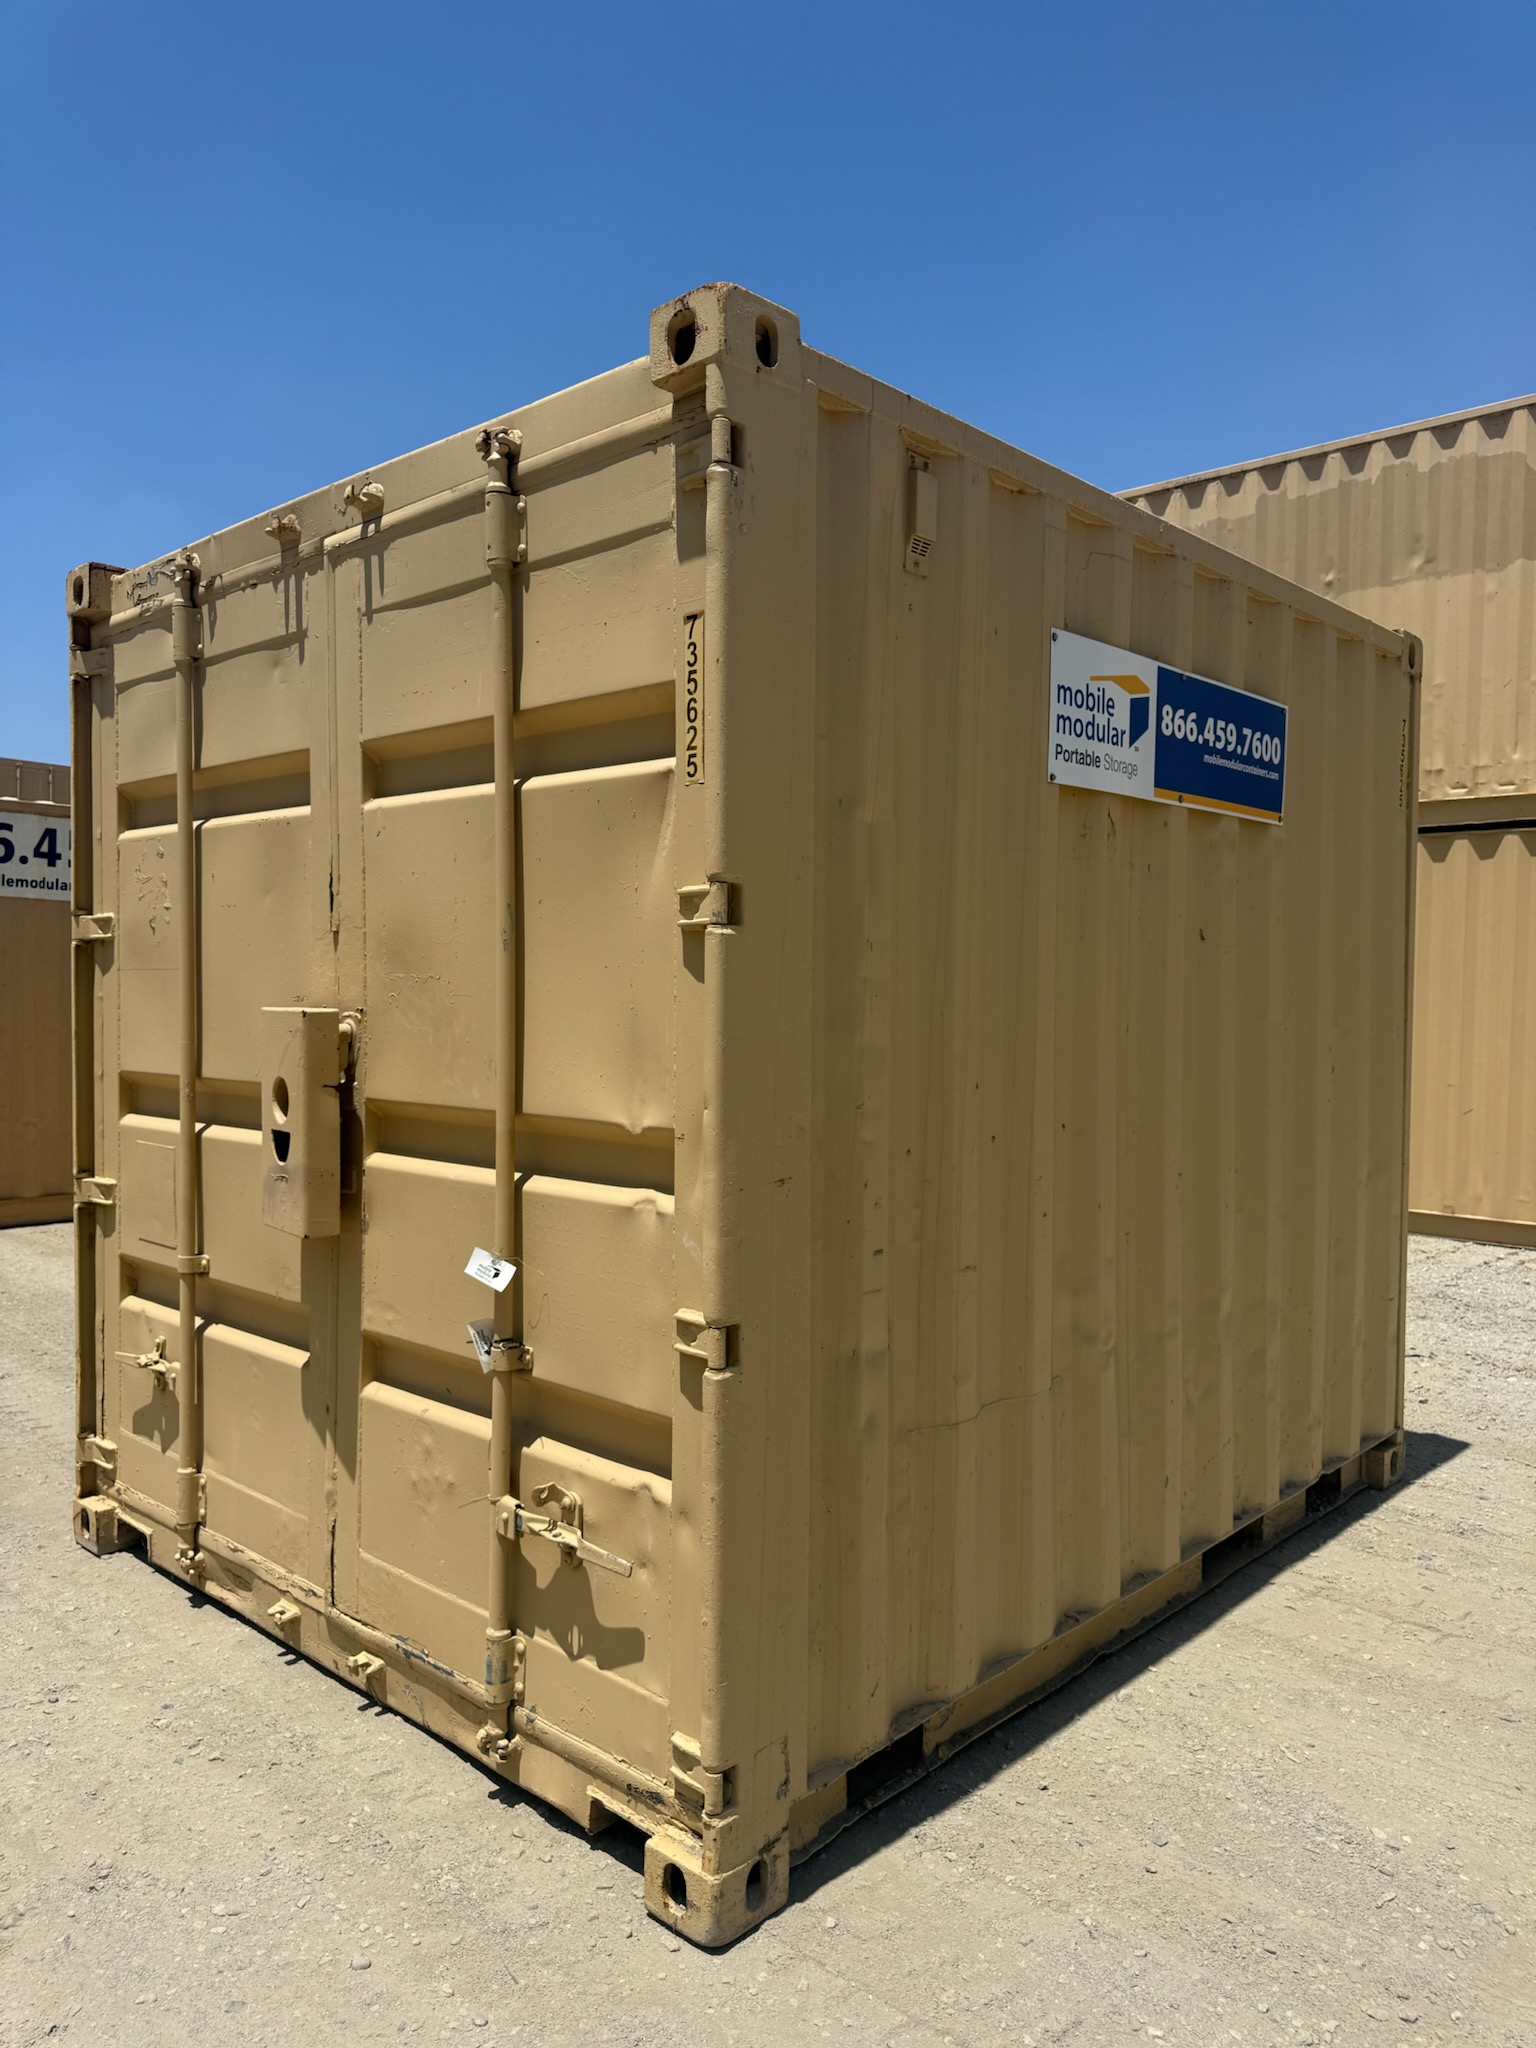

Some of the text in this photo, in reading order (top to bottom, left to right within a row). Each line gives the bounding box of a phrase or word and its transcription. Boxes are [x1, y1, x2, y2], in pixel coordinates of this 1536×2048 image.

[686, 614, 698, 778] 735625
[1057, 683, 1115, 717] mobile
[1056, 713, 1127, 748] modular
[1161, 704, 1281, 765] 866.459.7600
[1055, 743, 1139, 780] Portable Storage
[1203, 753, 1280, 780] mobilemodularcontainers.com
[1, 873, 71, 891] lemodula
